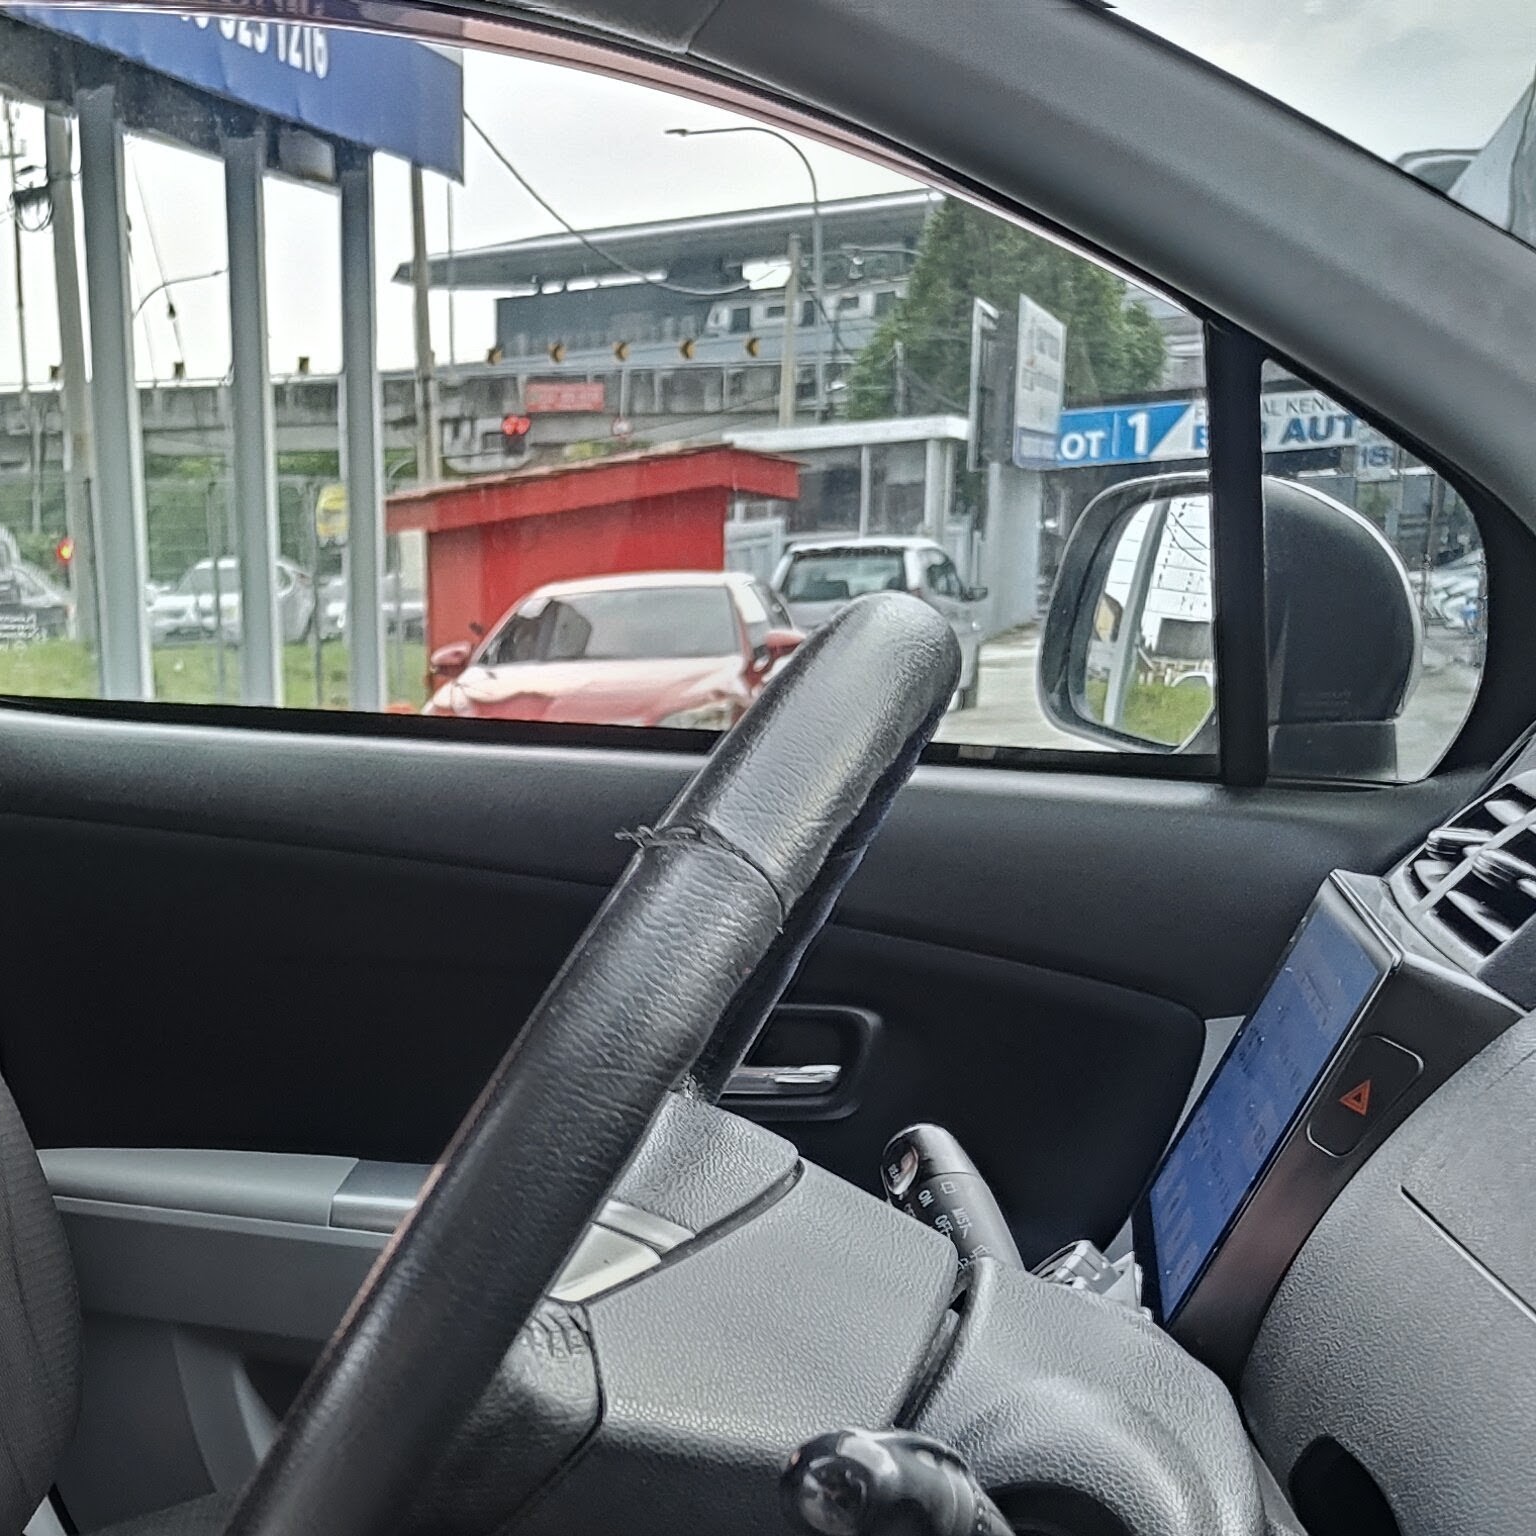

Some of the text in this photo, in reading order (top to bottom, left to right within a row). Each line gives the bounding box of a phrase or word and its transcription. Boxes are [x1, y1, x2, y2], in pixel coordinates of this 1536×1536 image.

[1058, 430, 1106, 461] OT
[1127, 412, 1151, 455] 1
[919, 1189, 935, 1208] ON
